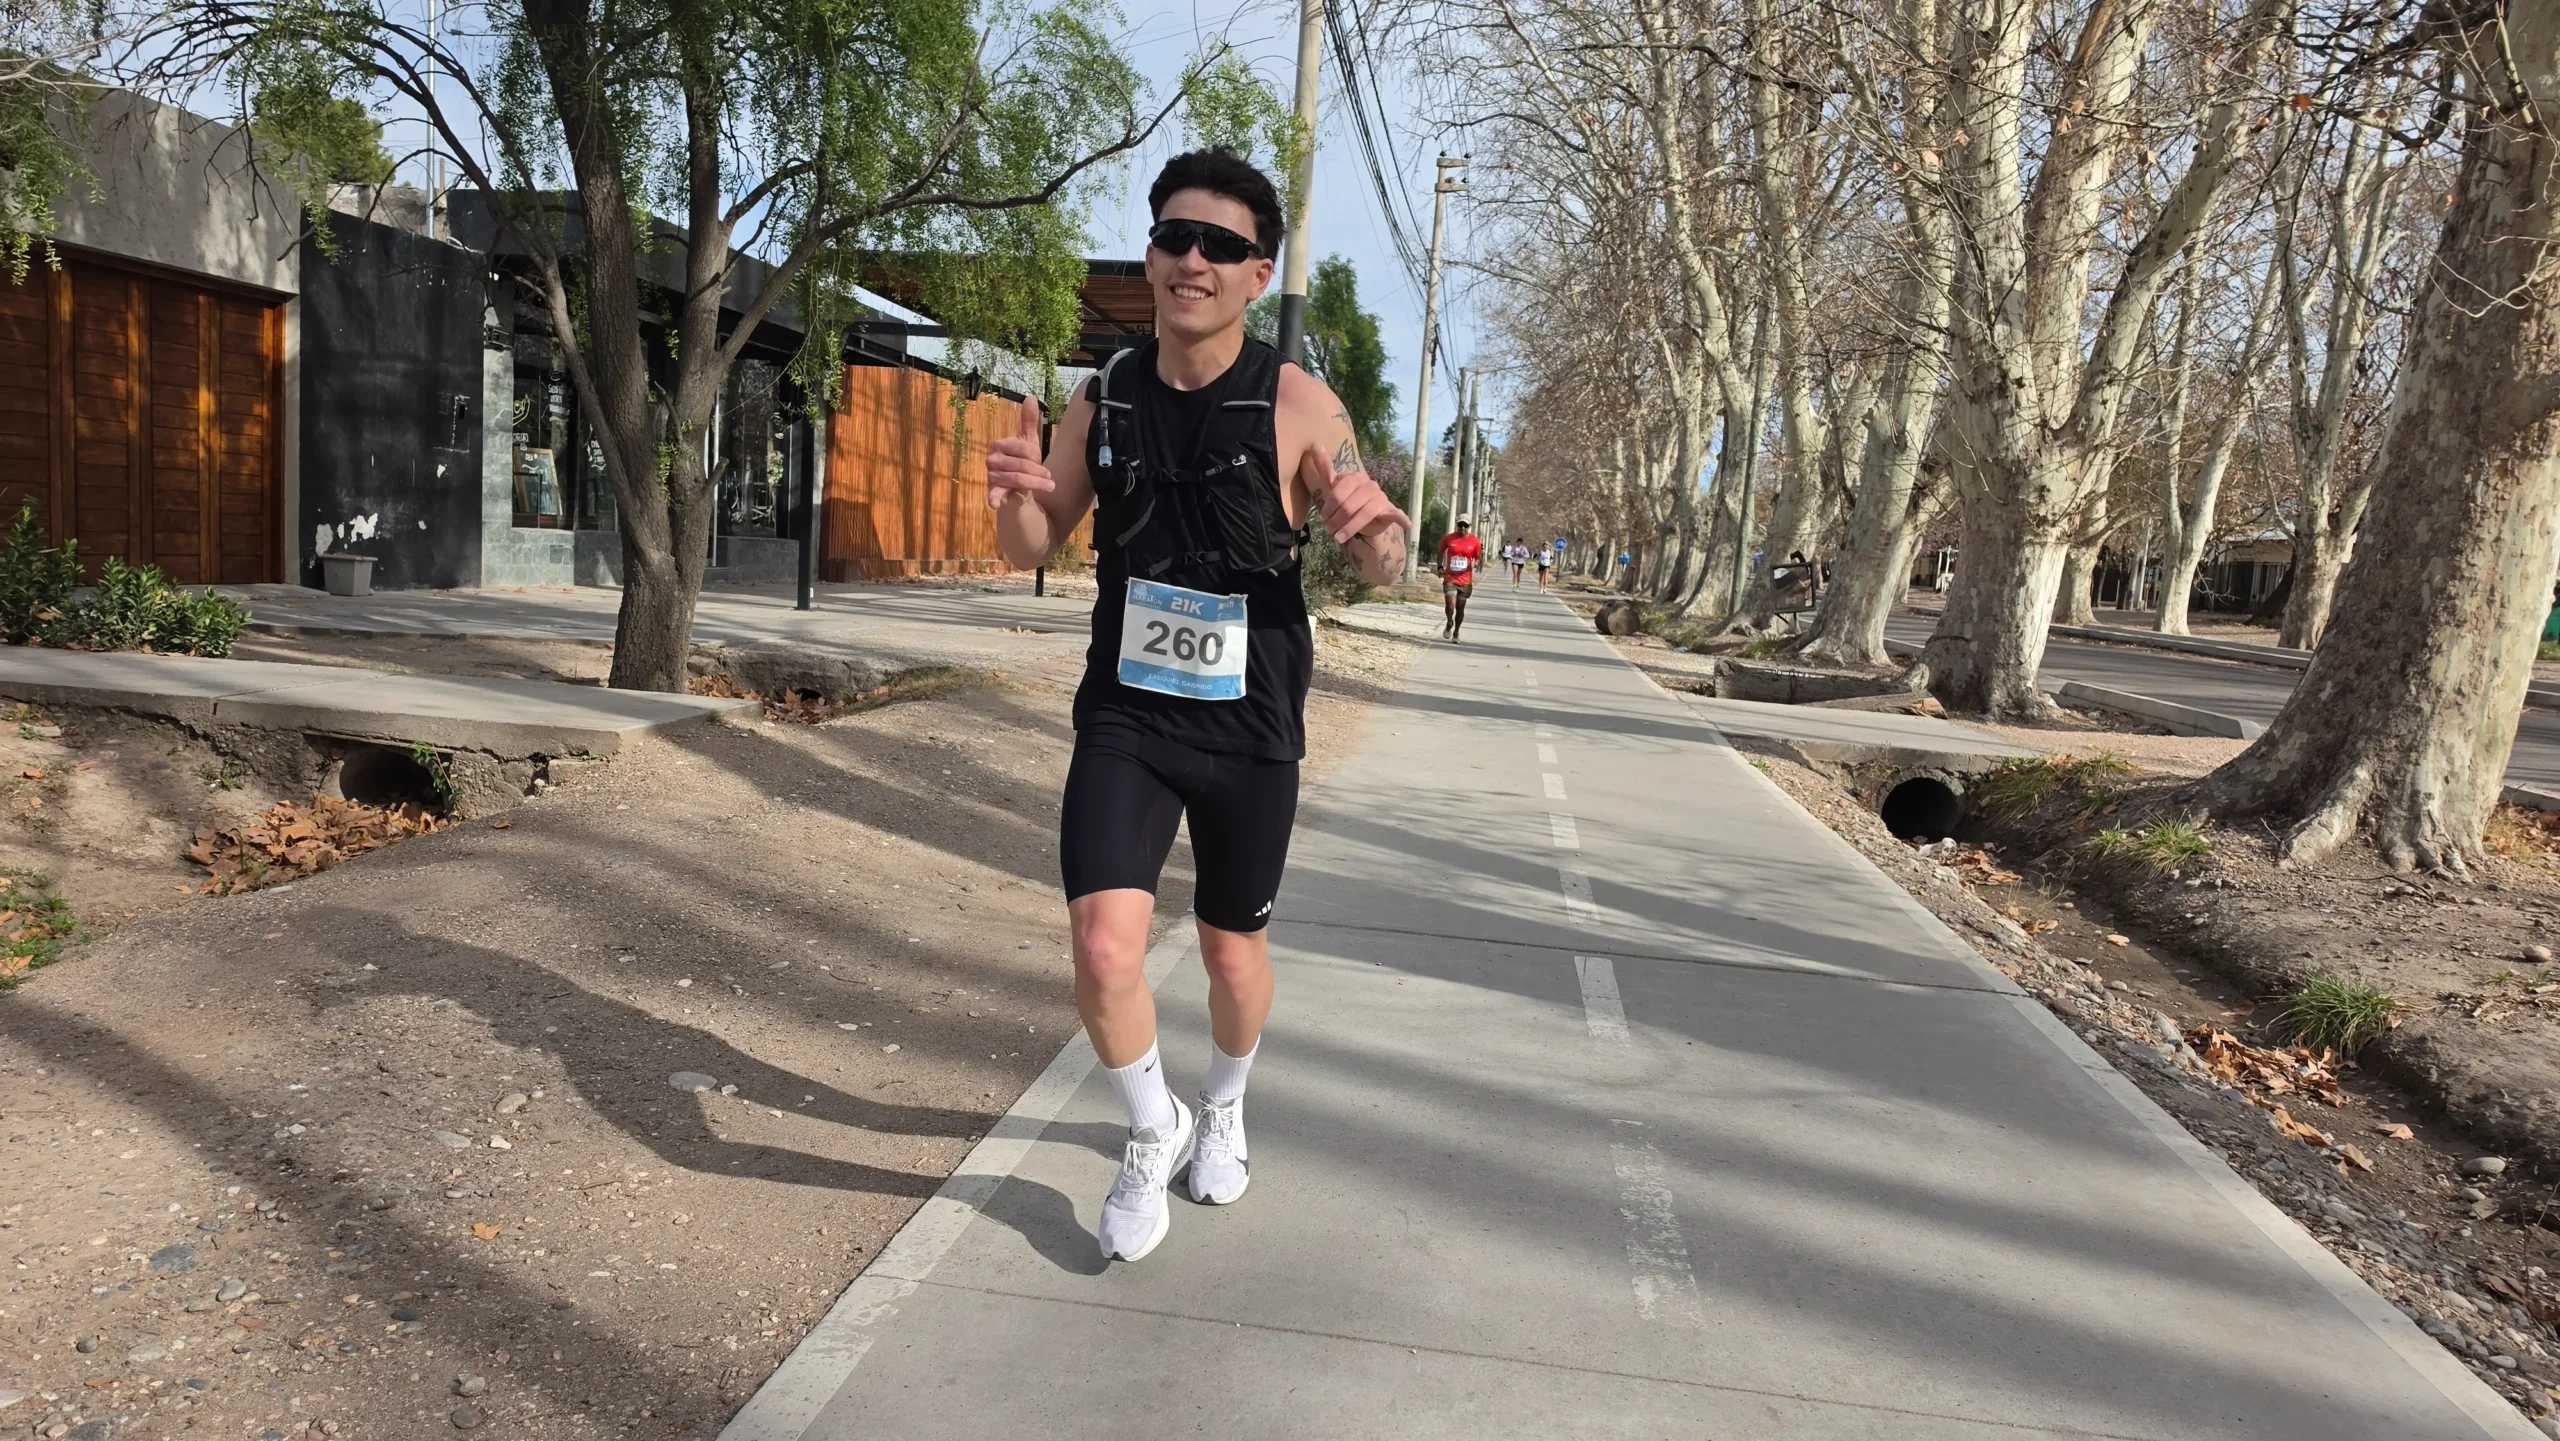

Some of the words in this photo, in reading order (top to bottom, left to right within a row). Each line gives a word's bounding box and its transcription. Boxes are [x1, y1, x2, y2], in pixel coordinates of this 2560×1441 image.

[1171, 596, 1205, 616] 21K
[1142, 620, 1224, 666] 260
[1148, 673, 1180, 685] EXEQUIEL
[1181, 680, 1213, 690] GARRIDO
